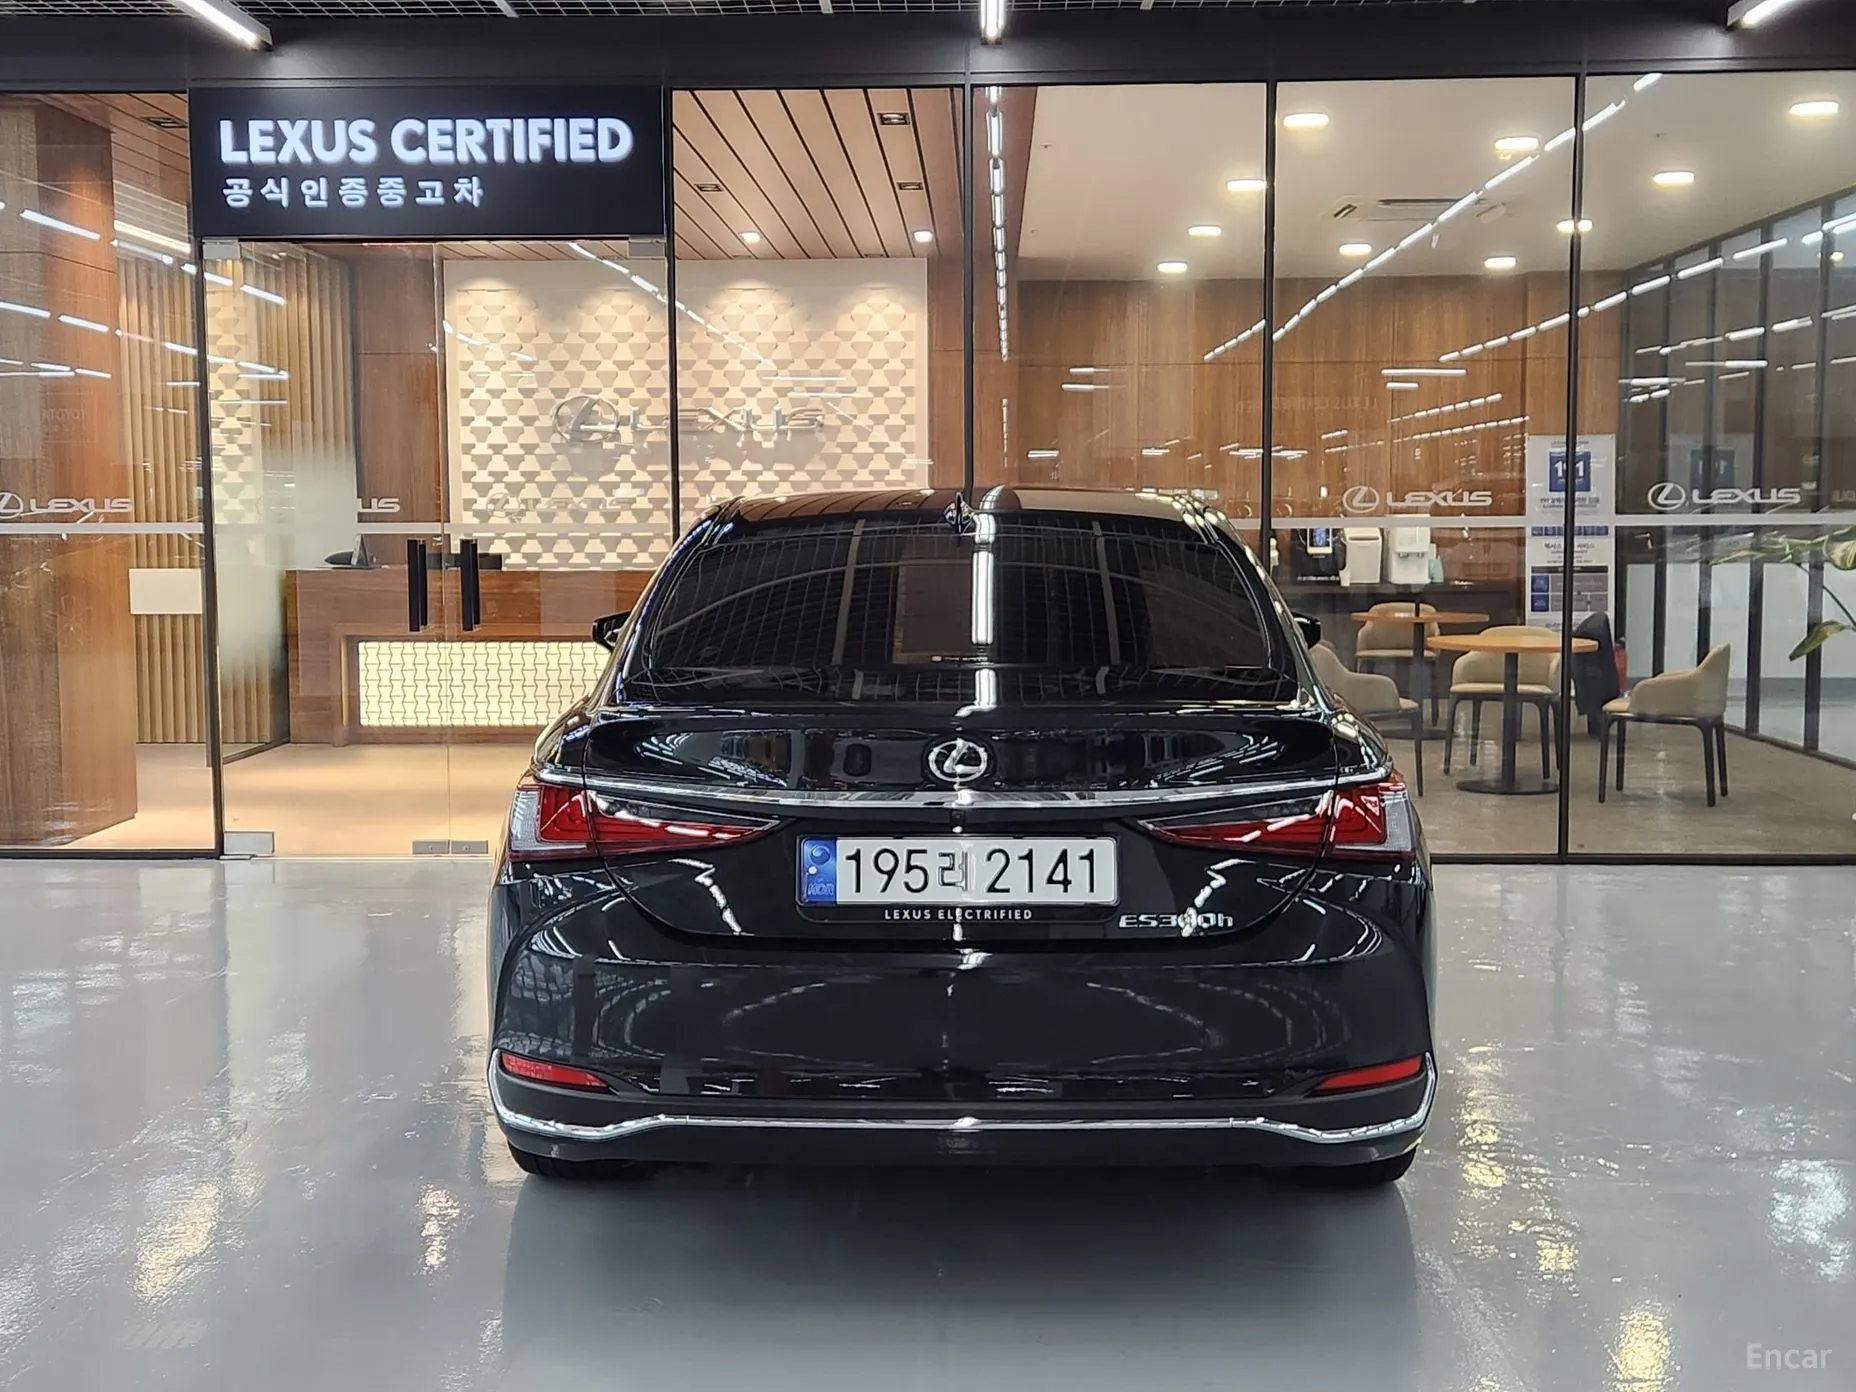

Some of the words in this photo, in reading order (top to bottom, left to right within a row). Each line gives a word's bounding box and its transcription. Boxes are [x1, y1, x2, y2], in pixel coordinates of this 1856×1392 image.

[219, 119, 379, 164] LEXUS
[390, 117, 633, 164] CERTIFIED
[1554, 461, 1585, 477] 11
[1386, 491, 1493, 507] LEXUS
[1692, 488, 1801, 504] LEXUS
[30, 498, 134, 513] LEXUS
[986, 848, 1095, 893] 2141
[884, 909, 931, 920] LEXUS
[938, 909, 1032, 920] ELECTRIFIED
